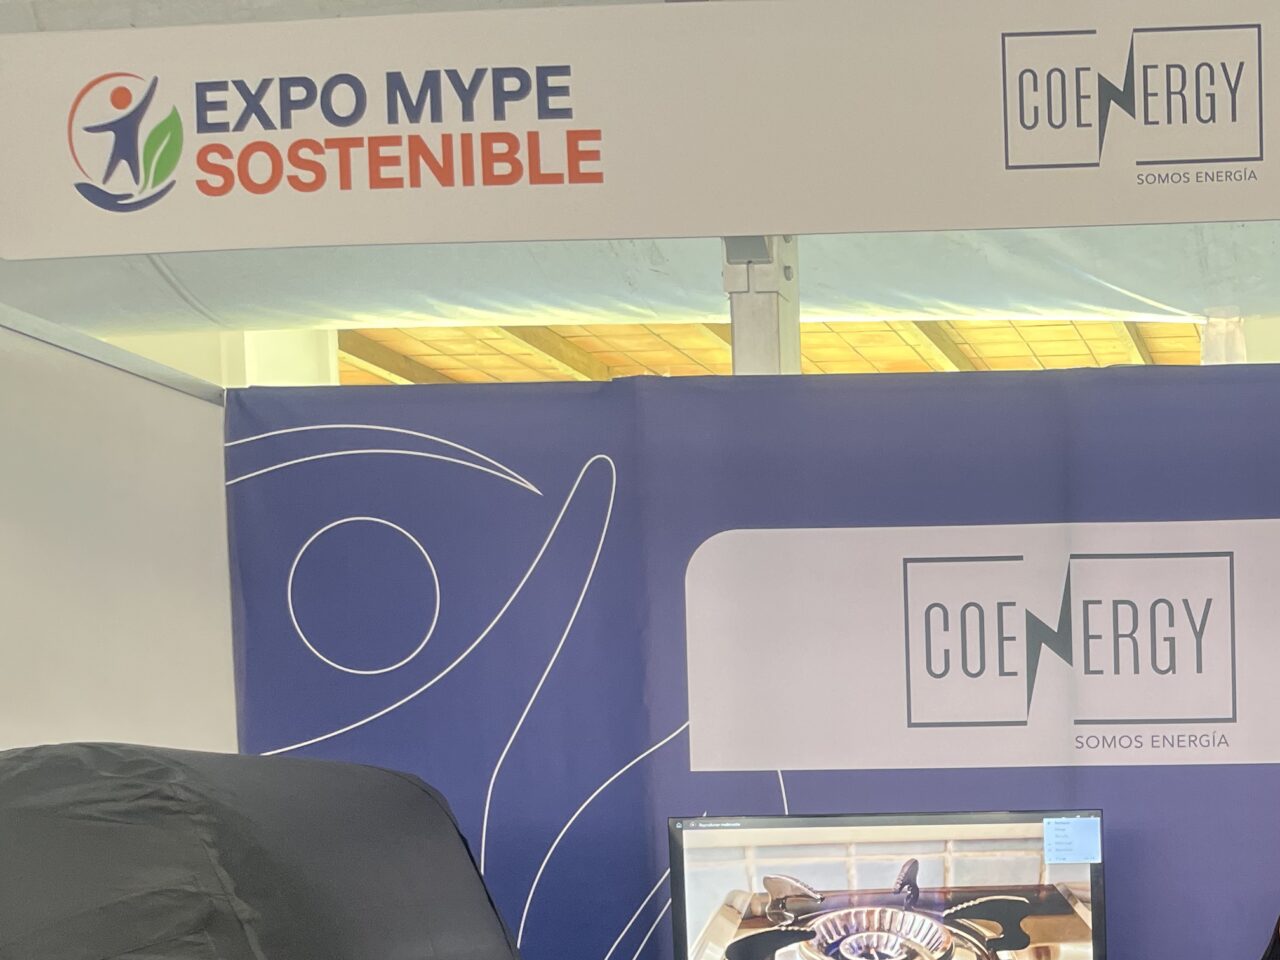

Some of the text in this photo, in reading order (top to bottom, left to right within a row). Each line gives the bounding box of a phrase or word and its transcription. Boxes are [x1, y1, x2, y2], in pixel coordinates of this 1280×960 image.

[195, 65, 573, 134] EXPO MYPE
[1017, 30, 1246, 166] COENERGY
[195, 129, 604, 197] SOSTENIBLE
[1136, 167, 1258, 186] SOMOS ENERGÍA
[924, 556, 1214, 720] COENERGY
[1074, 730, 1230, 750] SOMOS ENERGÍA
